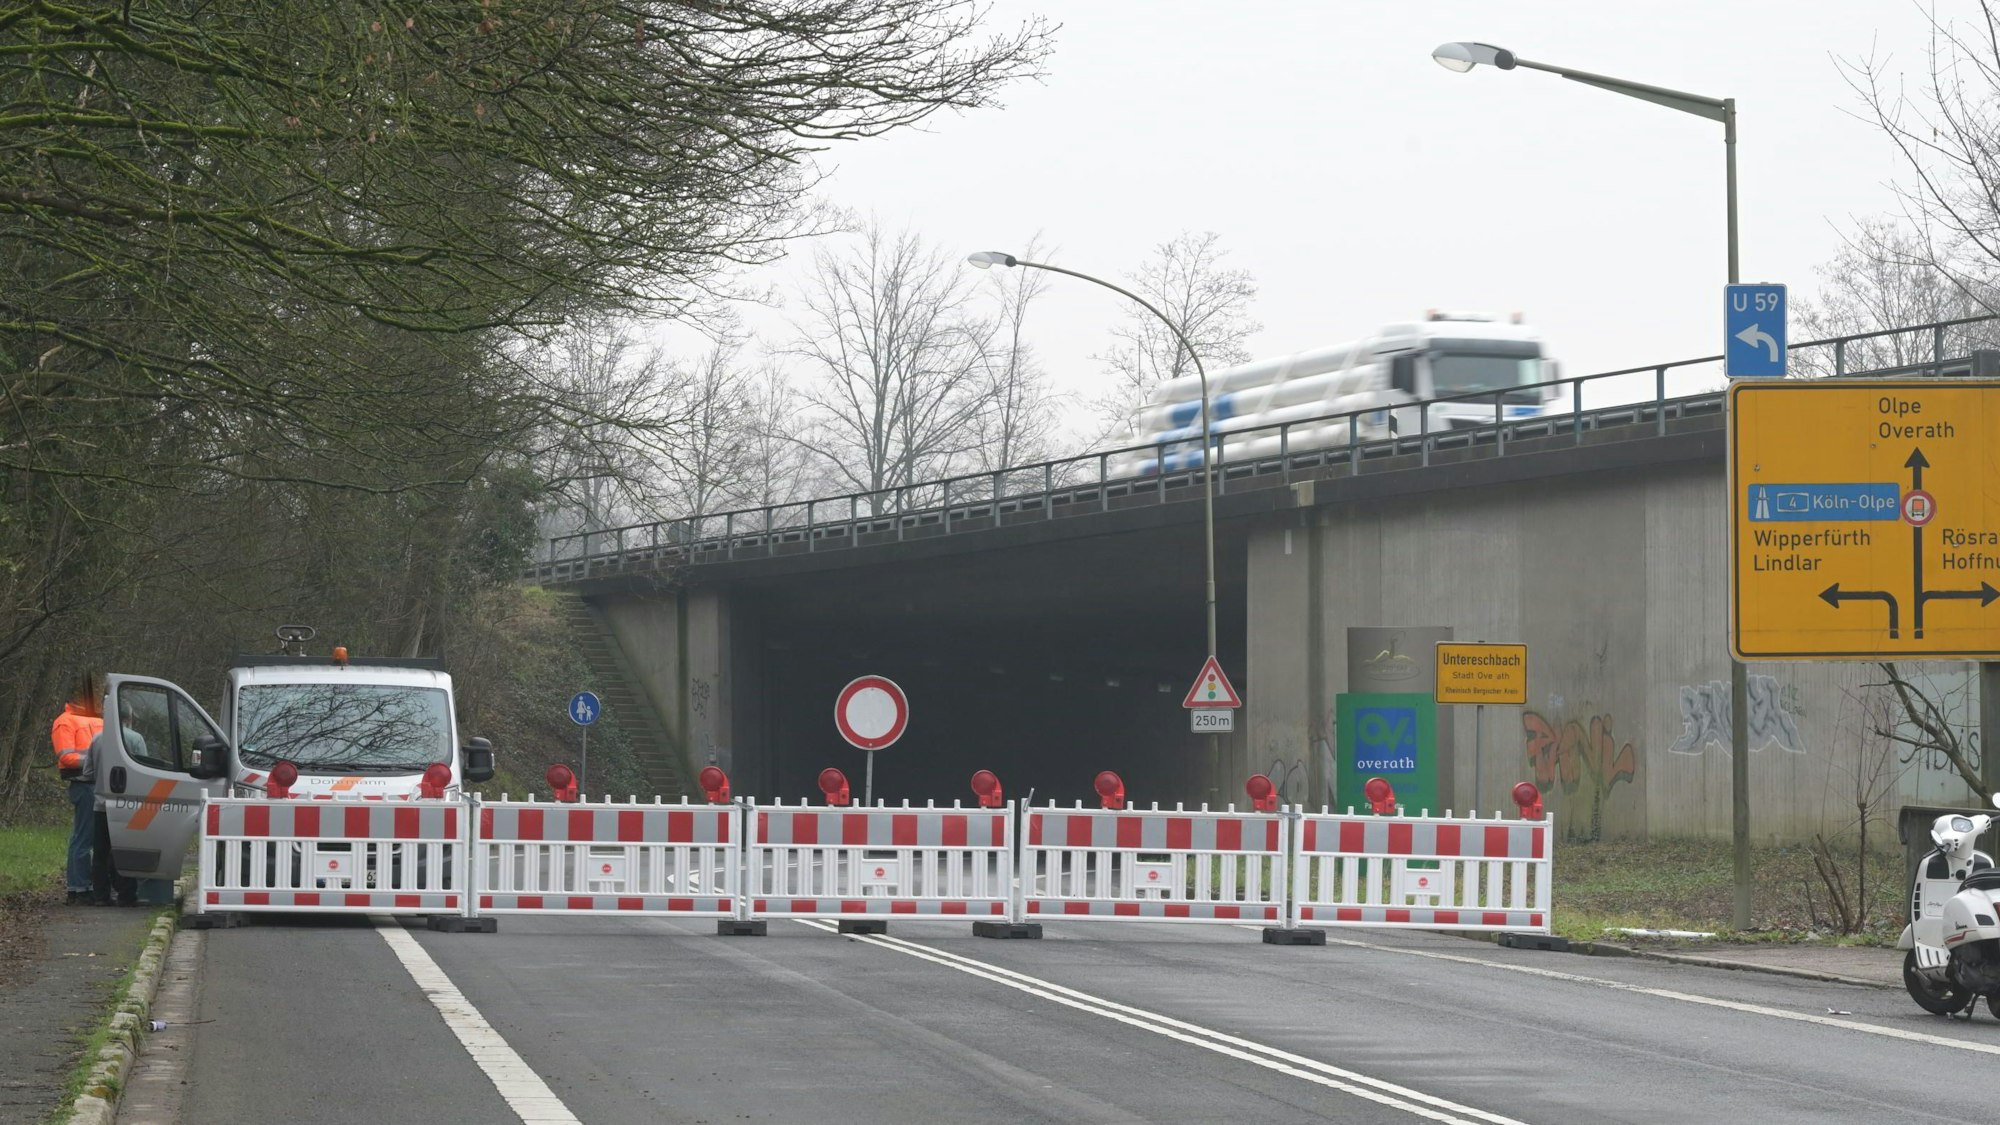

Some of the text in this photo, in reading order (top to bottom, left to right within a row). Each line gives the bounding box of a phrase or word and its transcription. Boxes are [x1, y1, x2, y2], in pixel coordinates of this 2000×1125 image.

[1733, 292, 1779, 312] U 59
[1878, 397, 1921, 418] Olpe
[1879, 421, 1955, 439] Overath
[1789, 494, 1896, 512] 4 Köln-Olpe
[1754, 529, 1871, 551] Wipperfürth
[1754, 554, 1823, 571] Lindlar
[1443, 652, 1521, 667] Untereschbach
[1452, 671, 1510, 680] Stadt Oveath
[1195, 715, 1230, 726] 250 m
[1357, 756, 1415, 769] overath
